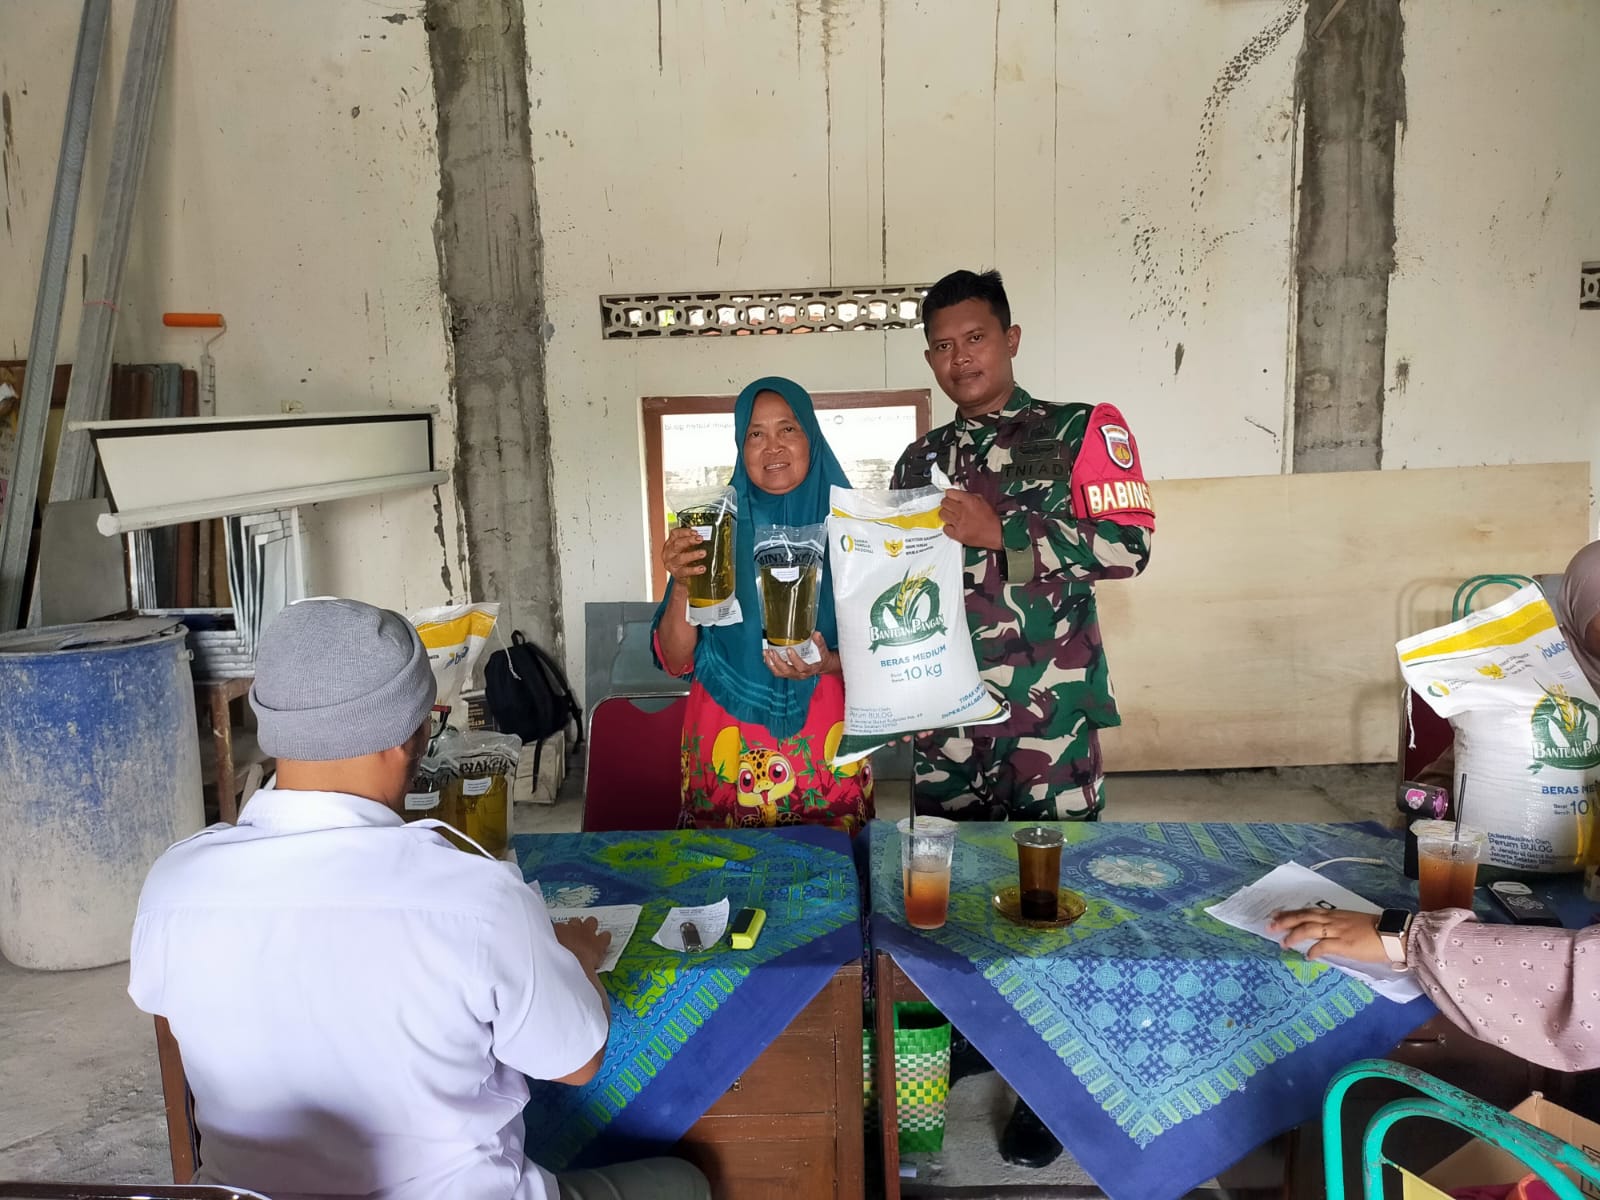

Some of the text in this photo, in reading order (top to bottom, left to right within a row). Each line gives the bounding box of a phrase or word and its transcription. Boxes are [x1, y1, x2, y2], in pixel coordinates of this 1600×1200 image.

[1005, 463, 1064, 478] TNI AD
[869, 613, 945, 642] BANTUAN PANGAN
[880, 644, 947, 667] BERAS MEDIUM
[903, 663, 943, 681] 10 kg
[1532, 741, 1582, 760] BANTUAN
[1541, 785, 1579, 795] BERAS
[1570, 799, 1589, 816] 10
[1488, 837, 1553, 853] Perum BULOG
